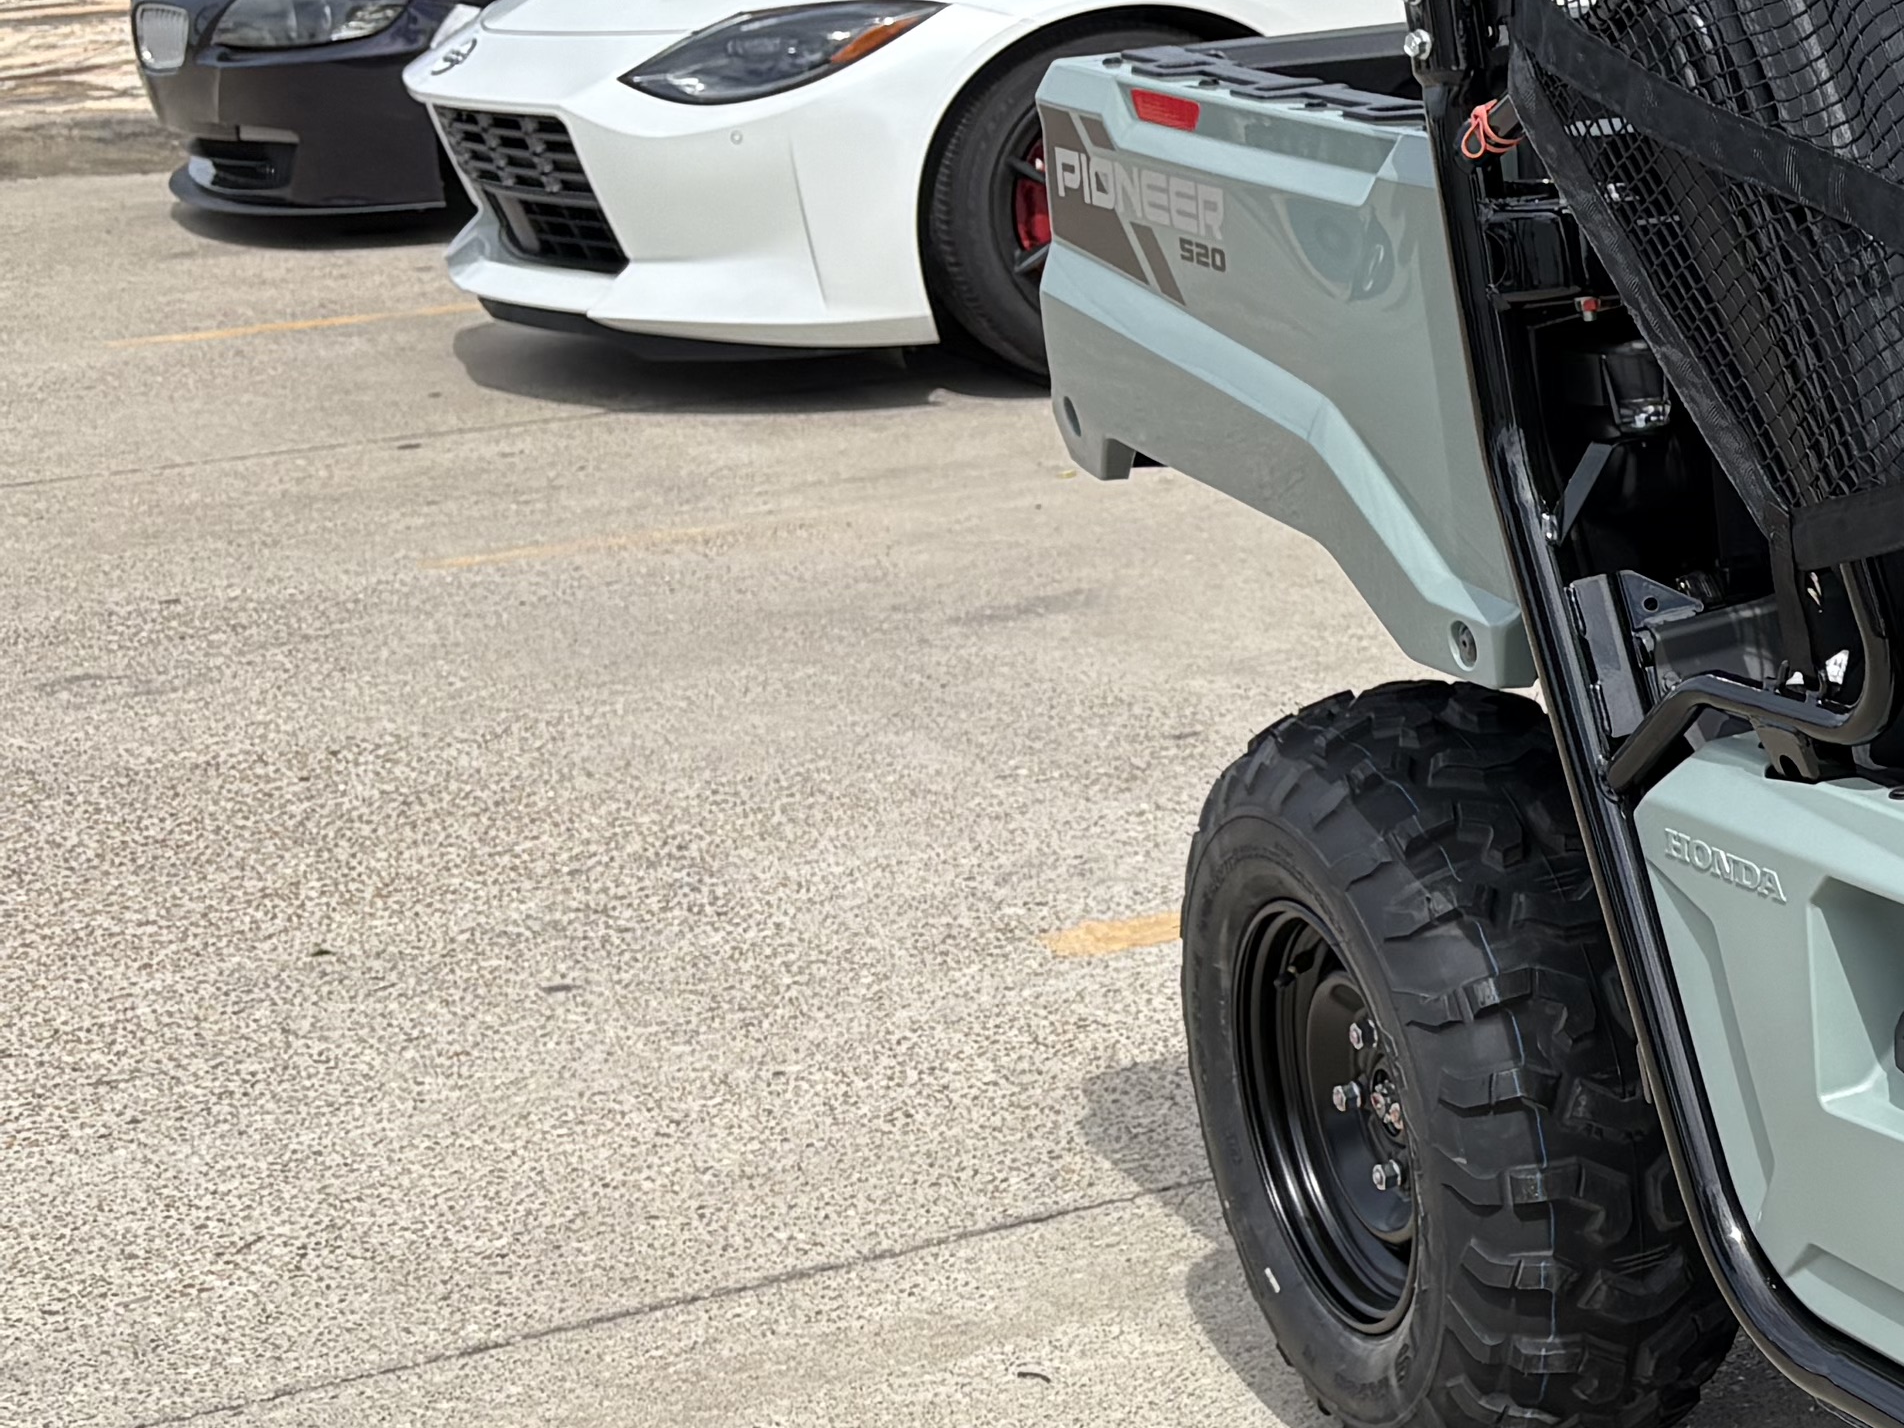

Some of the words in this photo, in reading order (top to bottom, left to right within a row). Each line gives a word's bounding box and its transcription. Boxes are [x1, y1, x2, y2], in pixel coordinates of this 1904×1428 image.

[1054, 146, 1225, 241] PIONEER
[1179, 236, 1227, 273] 520
[1663, 827, 1788, 905] HONDA
